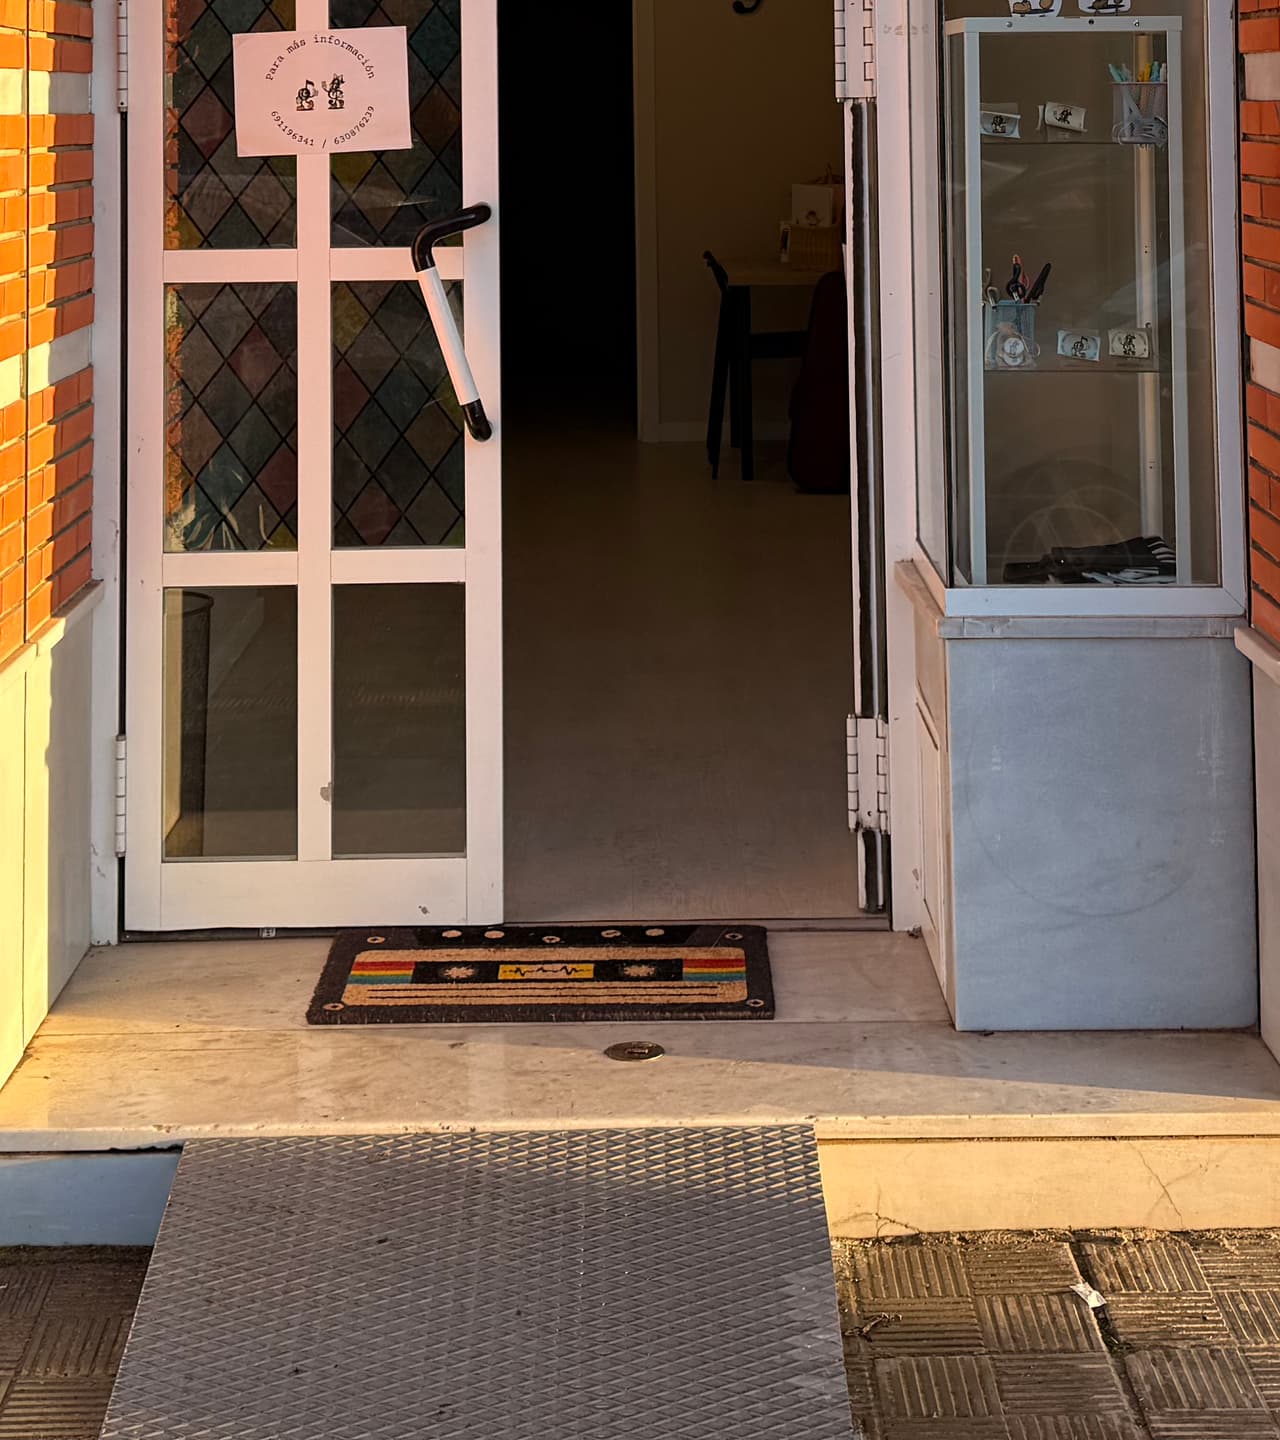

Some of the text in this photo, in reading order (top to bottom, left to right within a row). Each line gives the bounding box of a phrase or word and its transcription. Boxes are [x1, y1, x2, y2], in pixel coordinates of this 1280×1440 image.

[265, 34, 375, 81] Para más información
[271, 110, 314, 146] 691196341
[333, 105, 375, 145] 630876239
